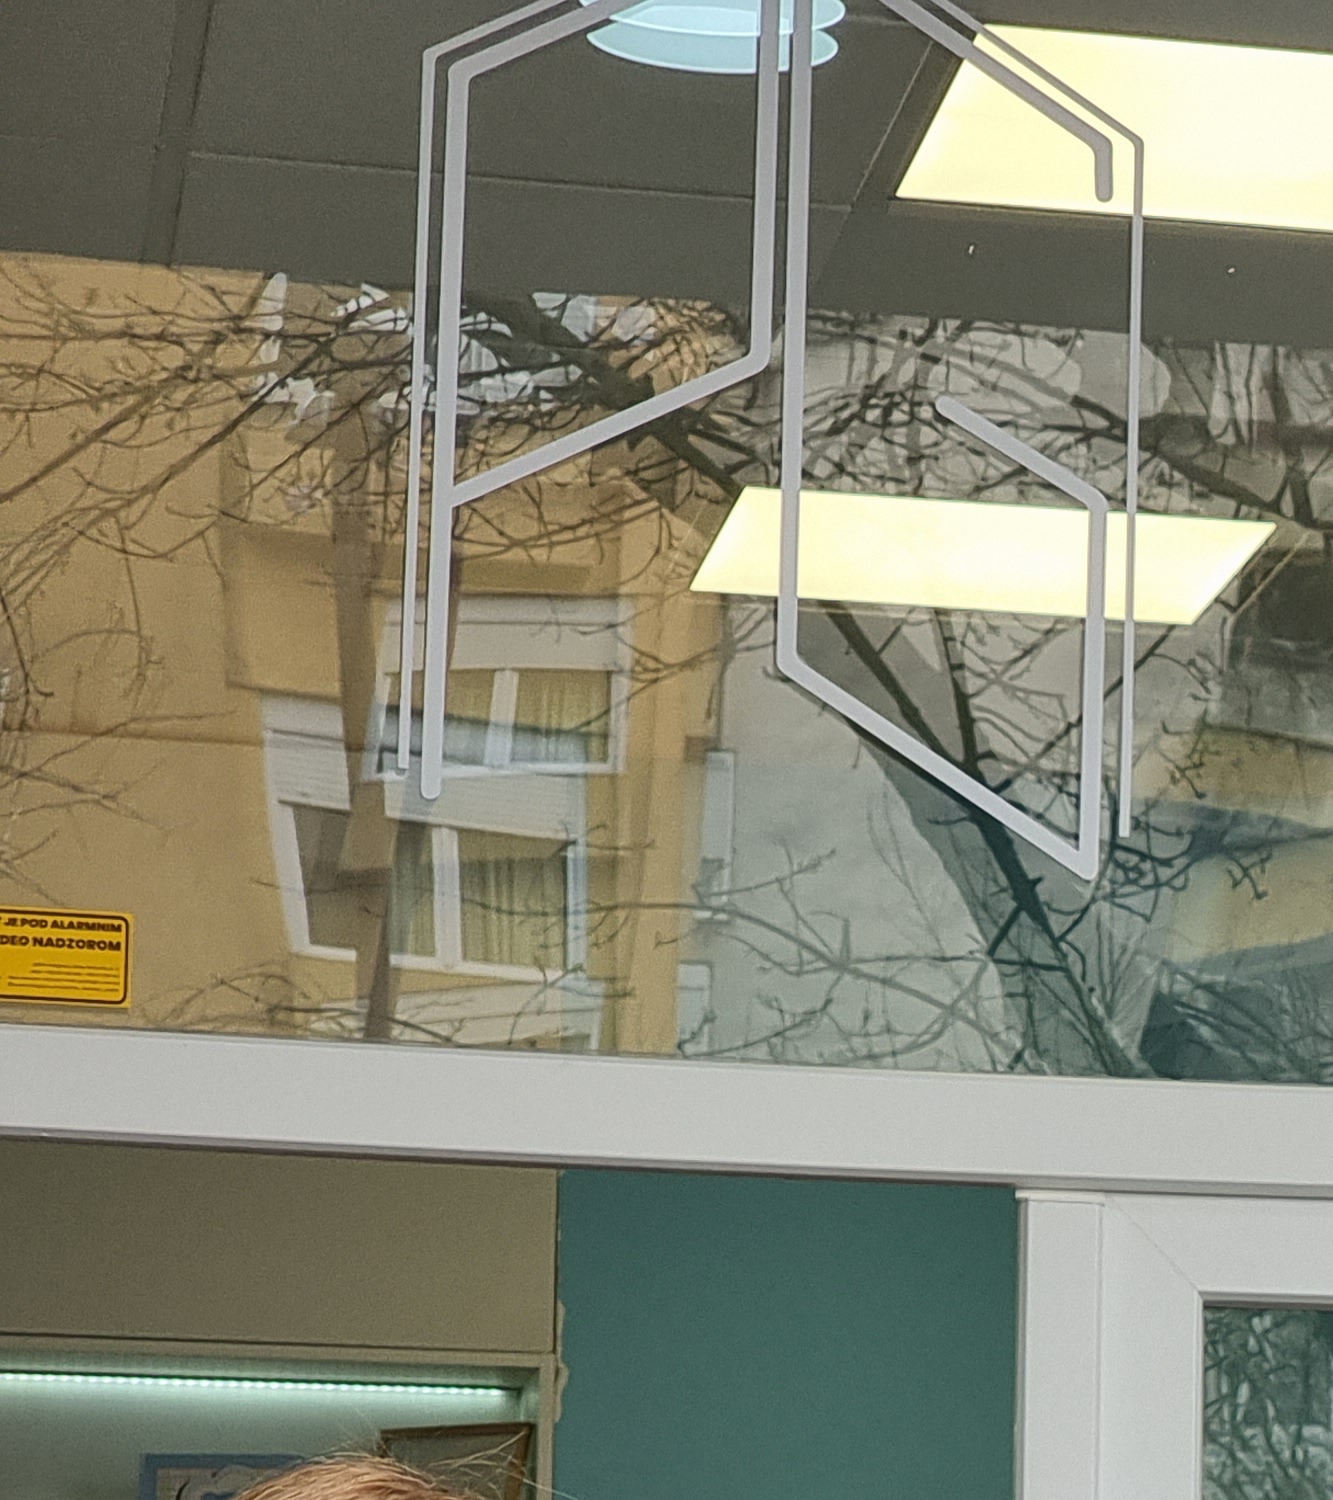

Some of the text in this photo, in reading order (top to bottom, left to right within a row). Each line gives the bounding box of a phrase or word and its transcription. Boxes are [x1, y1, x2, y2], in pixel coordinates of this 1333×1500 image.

[20, 918, 49, 929] POD
[50, 919, 122, 933] ALARMNIM
[32, 936, 122, 952] NADZOROM
